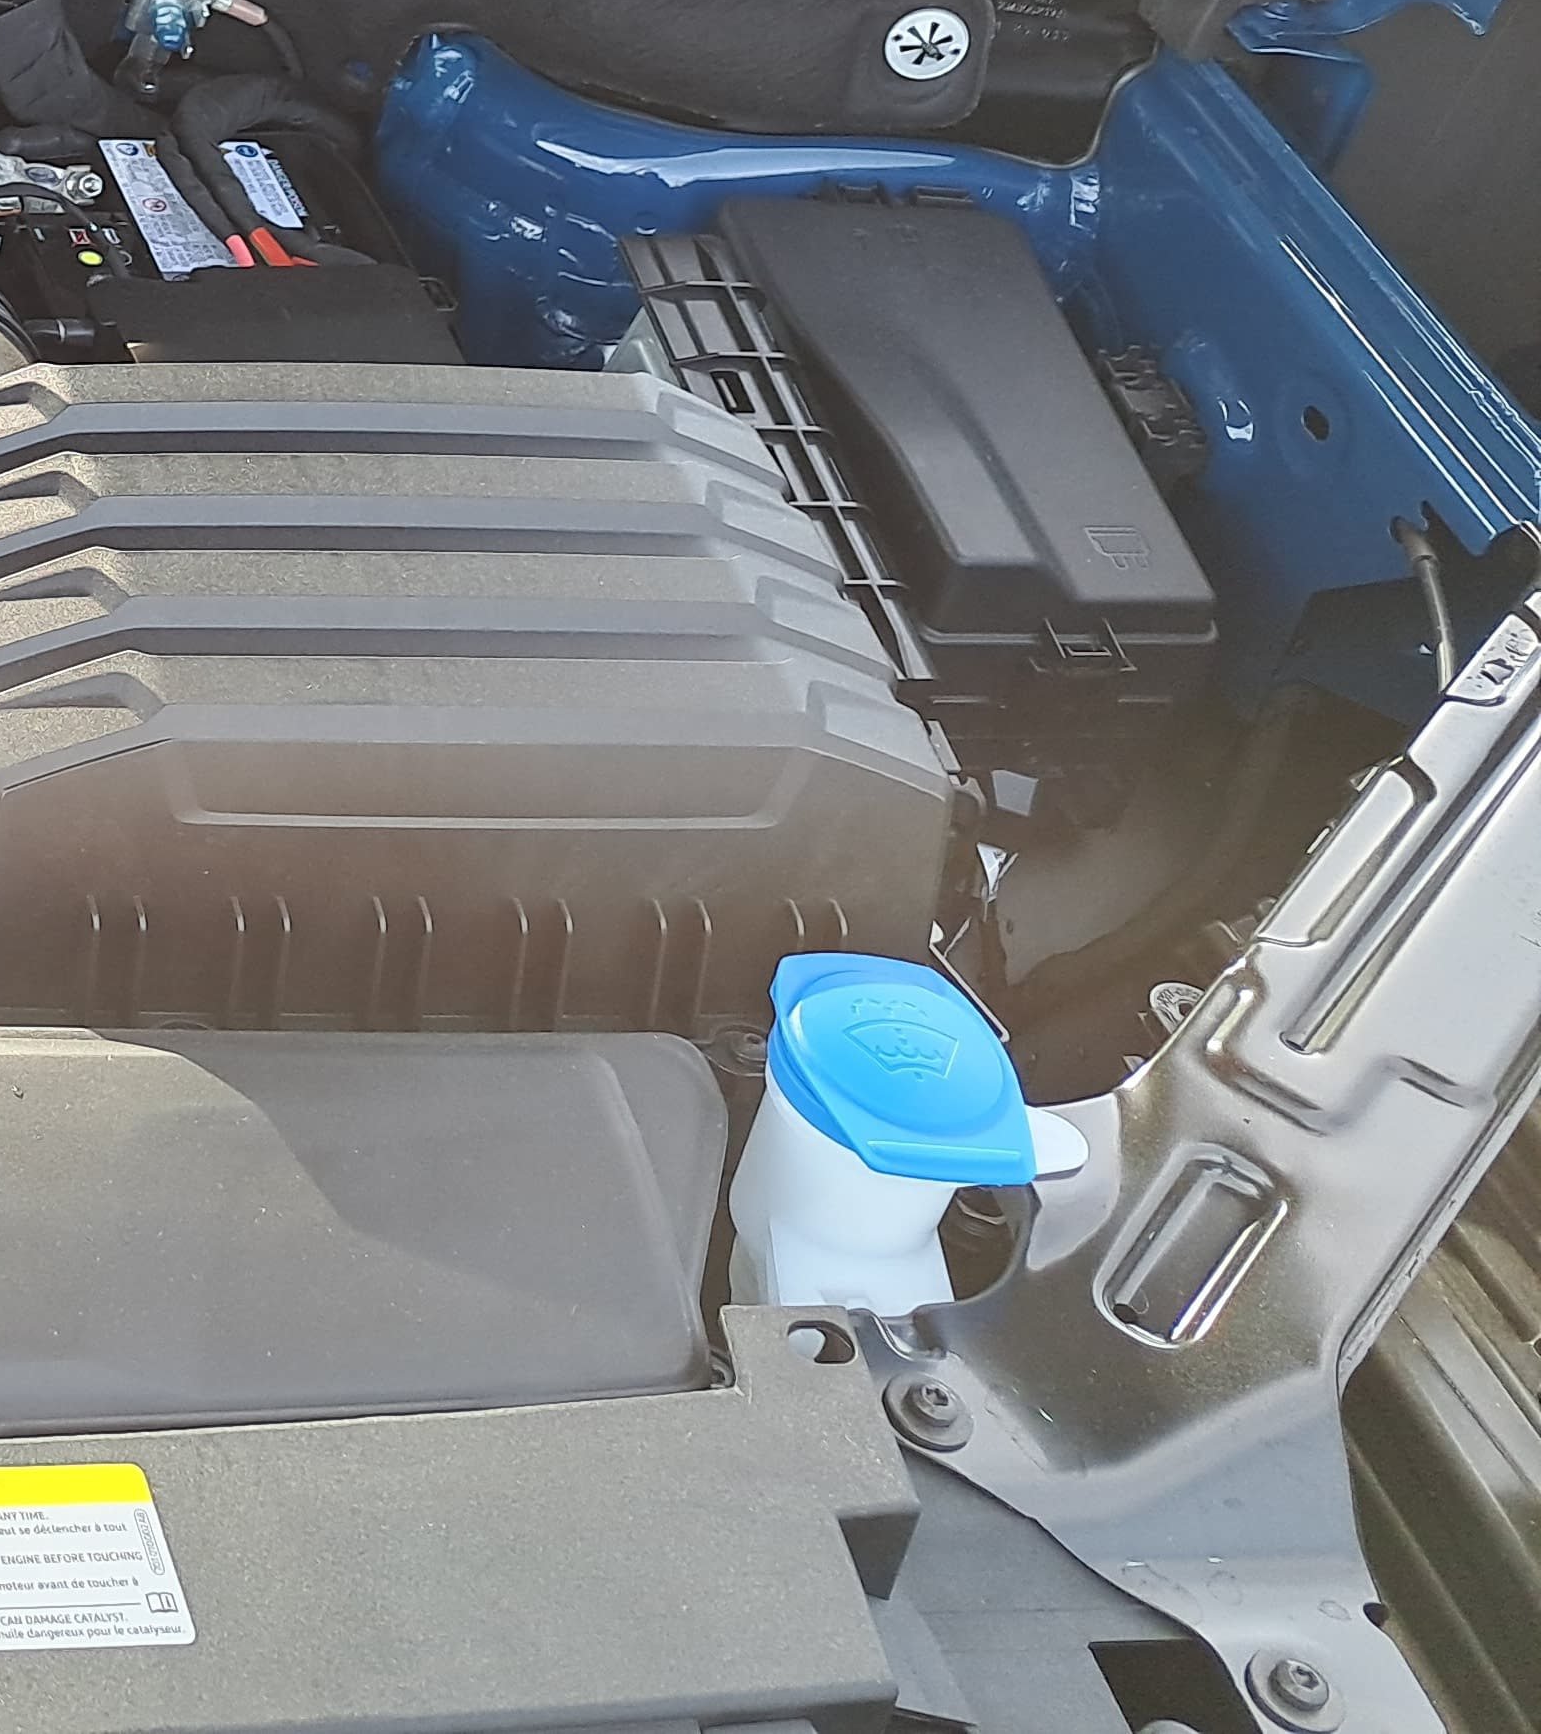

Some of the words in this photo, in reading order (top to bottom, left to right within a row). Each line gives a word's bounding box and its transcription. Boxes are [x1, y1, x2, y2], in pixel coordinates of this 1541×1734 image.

[19, 1511, 48, 1520] TIME.
[19, 1527, 30, 1535] se
[34, 1523, 91, 1534] déclencher
[104, 1523, 127, 1531] tout
[1, 1554, 41, 1564] ENGINE
[44, 1553, 85, 1564] BEFORE
[88, 1552, 142, 1562] TOUCHING
[38, 1580, 68, 1590] avant
[72, 1578, 85, 1588] de
[87, 1578, 129, 1587] toucher
[1, 1616, 22, 1625] CAN
[26, 1614, 72, 1624] DAMAGE
[75, 1612, 128, 1624] CATALYST.
[27, 1628, 84, 1640] dangereux
[87, 1627, 111, 1638] pour
[114, 1625, 124, 1635] le
